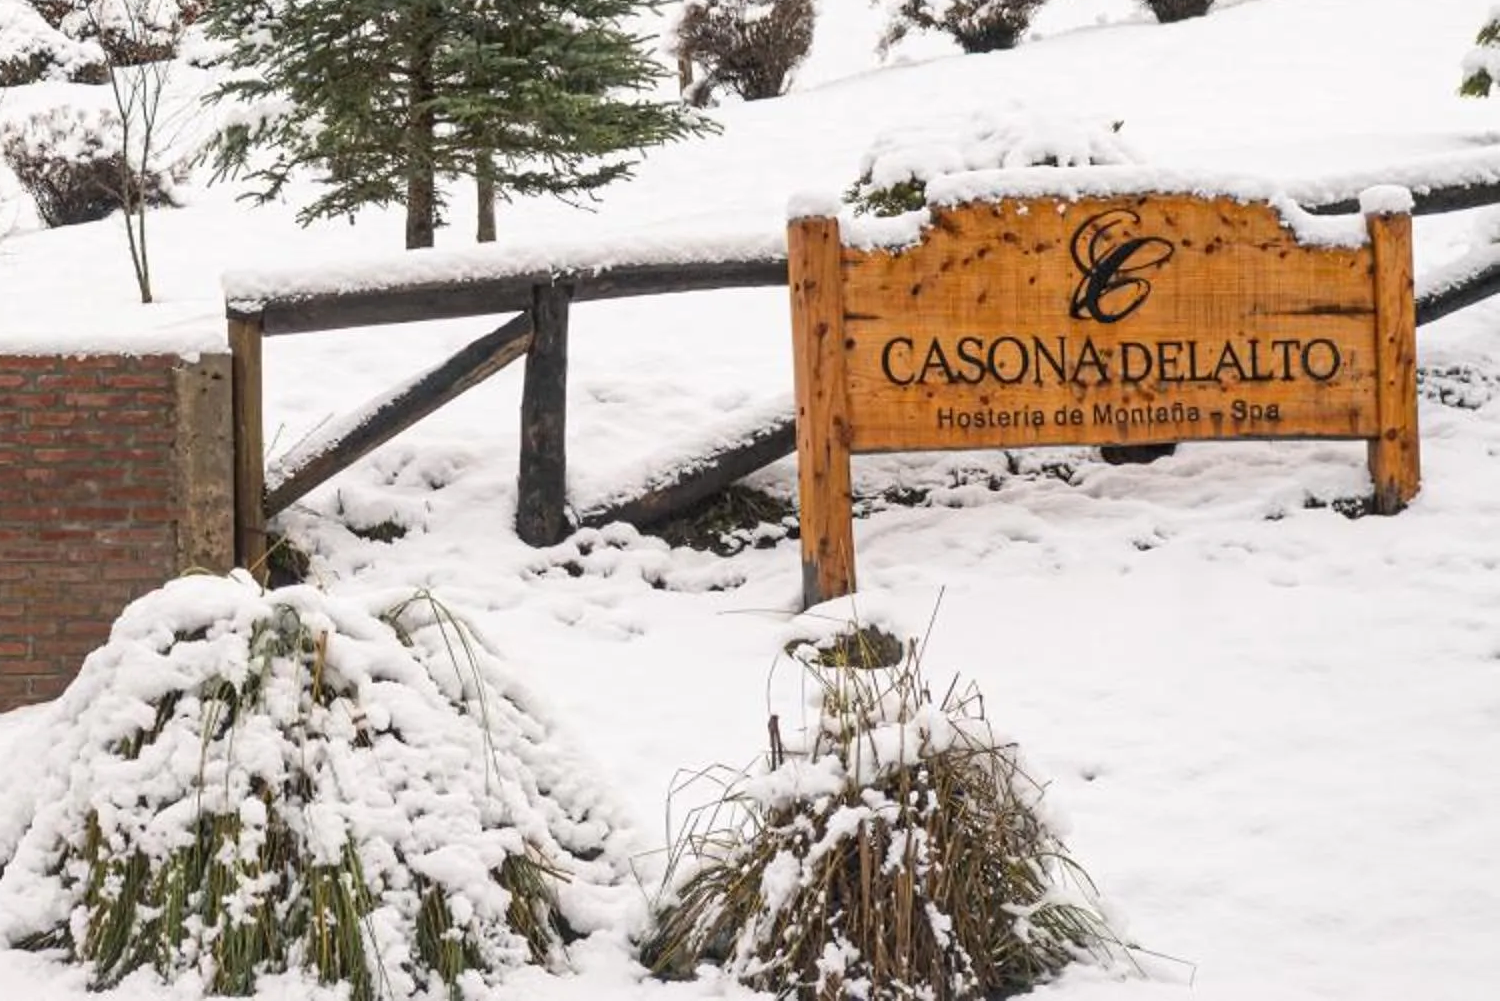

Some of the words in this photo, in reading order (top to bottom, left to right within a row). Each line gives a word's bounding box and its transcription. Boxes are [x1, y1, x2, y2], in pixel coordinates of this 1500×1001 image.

[881, 335, 1112, 386] CASONA
[1054, 405, 1084, 426] de
[1093, 401, 1200, 426] Montaña
[1230, 399, 1280, 423] Spa
